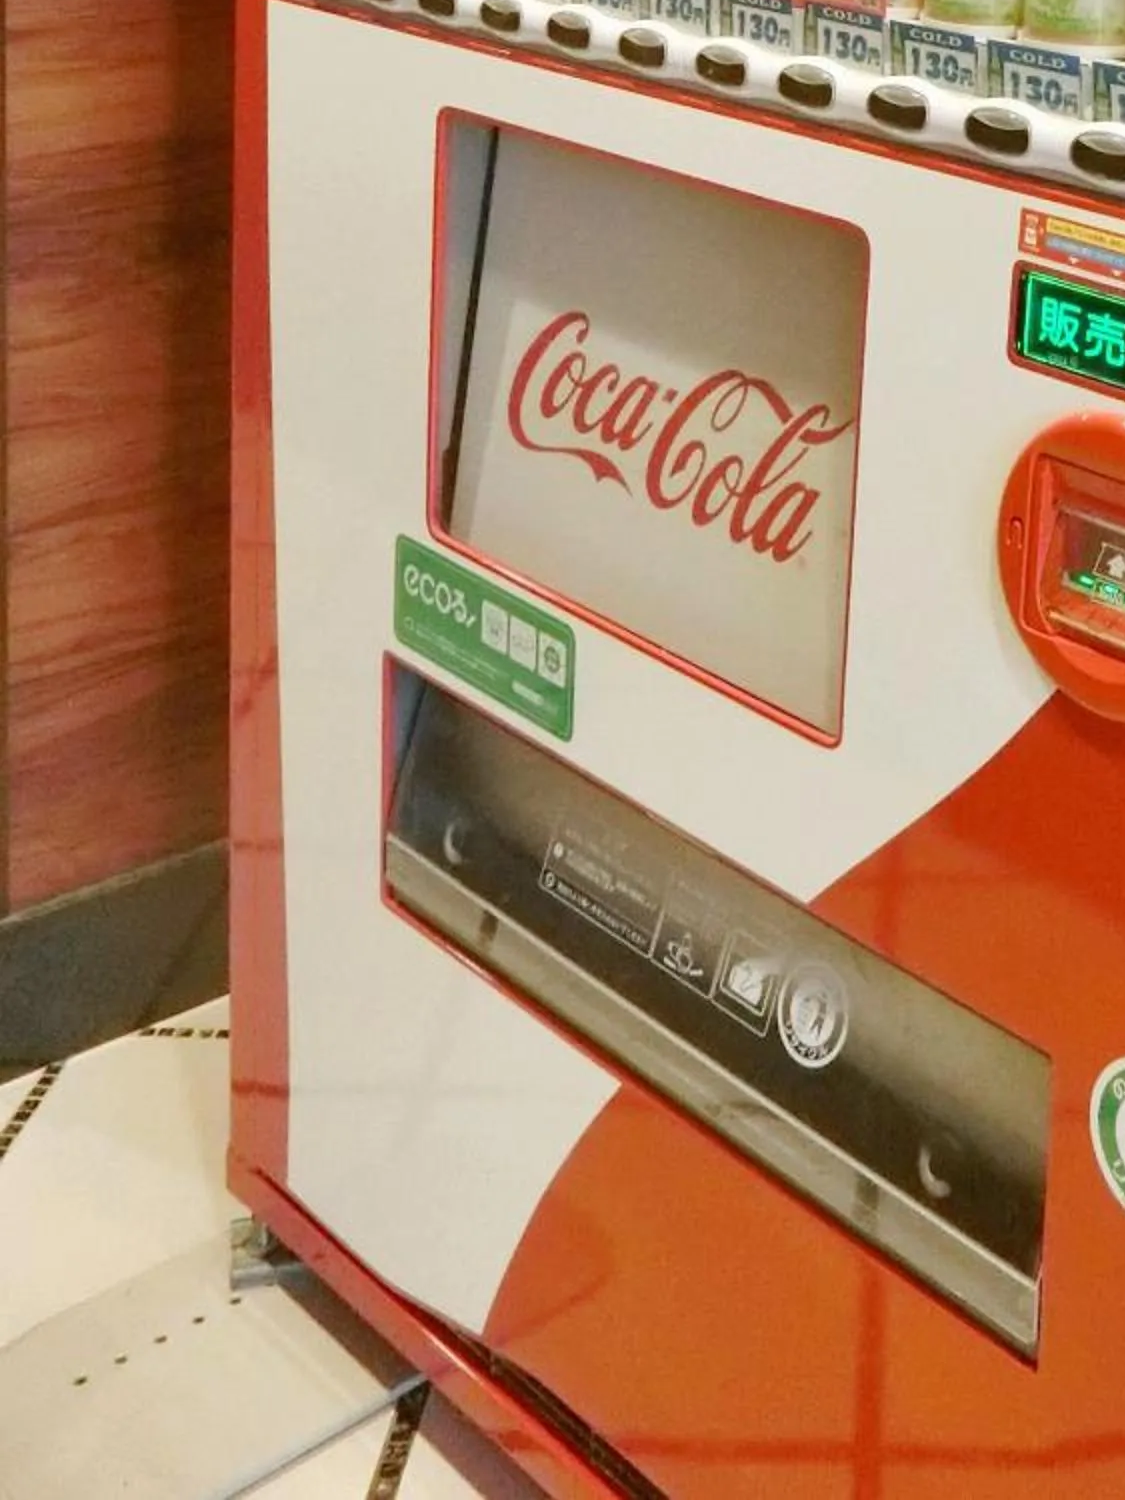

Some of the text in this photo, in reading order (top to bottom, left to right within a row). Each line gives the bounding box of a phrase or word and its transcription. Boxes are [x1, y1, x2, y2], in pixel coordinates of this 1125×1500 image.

[823, 7, 872, 25] COLD
[910, 26, 963, 47] COLD
[823, 27, 882, 68] 130円
[910, 47, 976, 89] 130円
[1009, 48, 1066, 70] COLD
[1009, 71, 1080, 112] 130円
[505, 311, 855, 565] Coca-Cola
